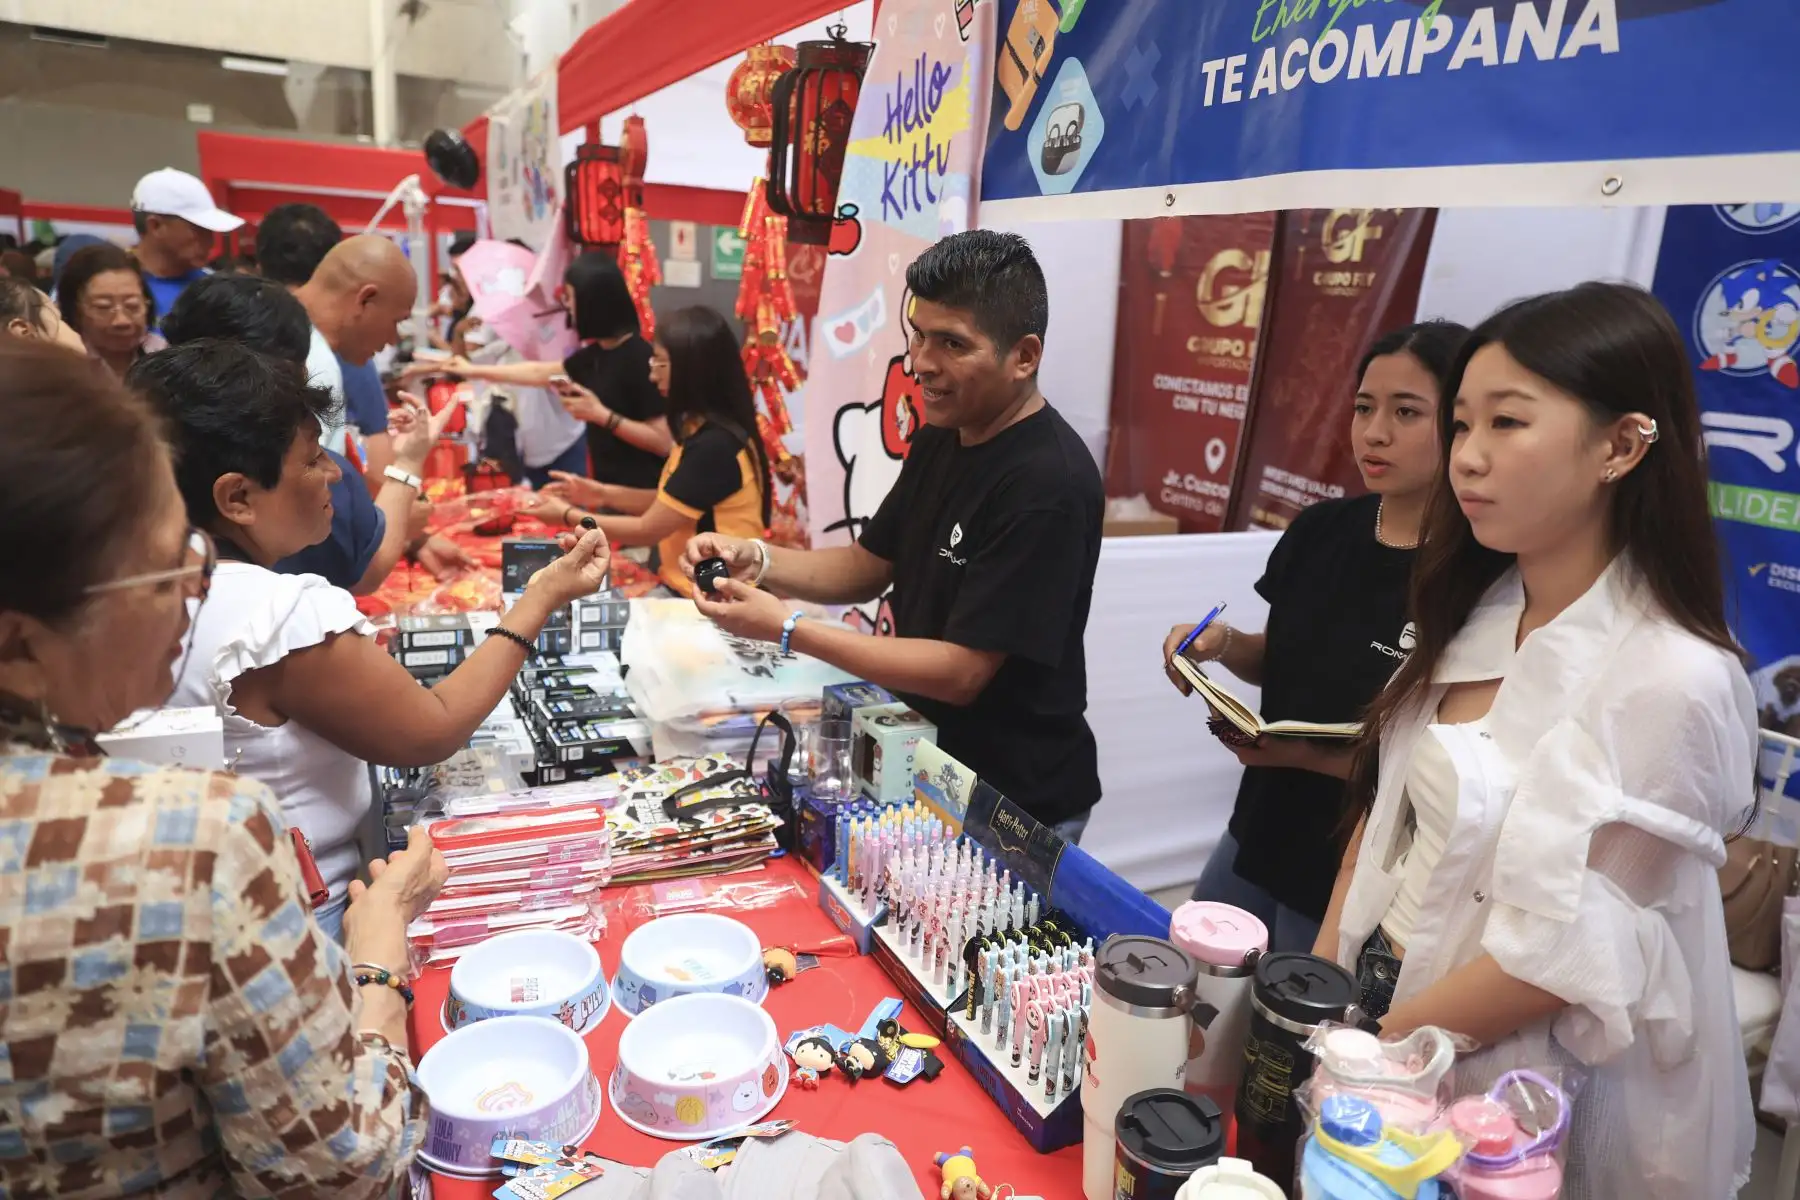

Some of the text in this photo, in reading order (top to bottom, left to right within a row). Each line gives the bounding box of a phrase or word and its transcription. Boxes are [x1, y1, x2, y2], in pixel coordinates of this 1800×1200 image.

[883, 52, 952, 144] Hello
[1202, 54, 1248, 107] TE
[881, 132, 951, 222] Kitty
[1700, 411, 1800, 474] R
[1160, 487, 1204, 511] Centro
[1769, 562, 1800, 582] DIS
[434, 1116, 454, 1141] LOLA
[432, 1137, 462, 1163] BUNNY
